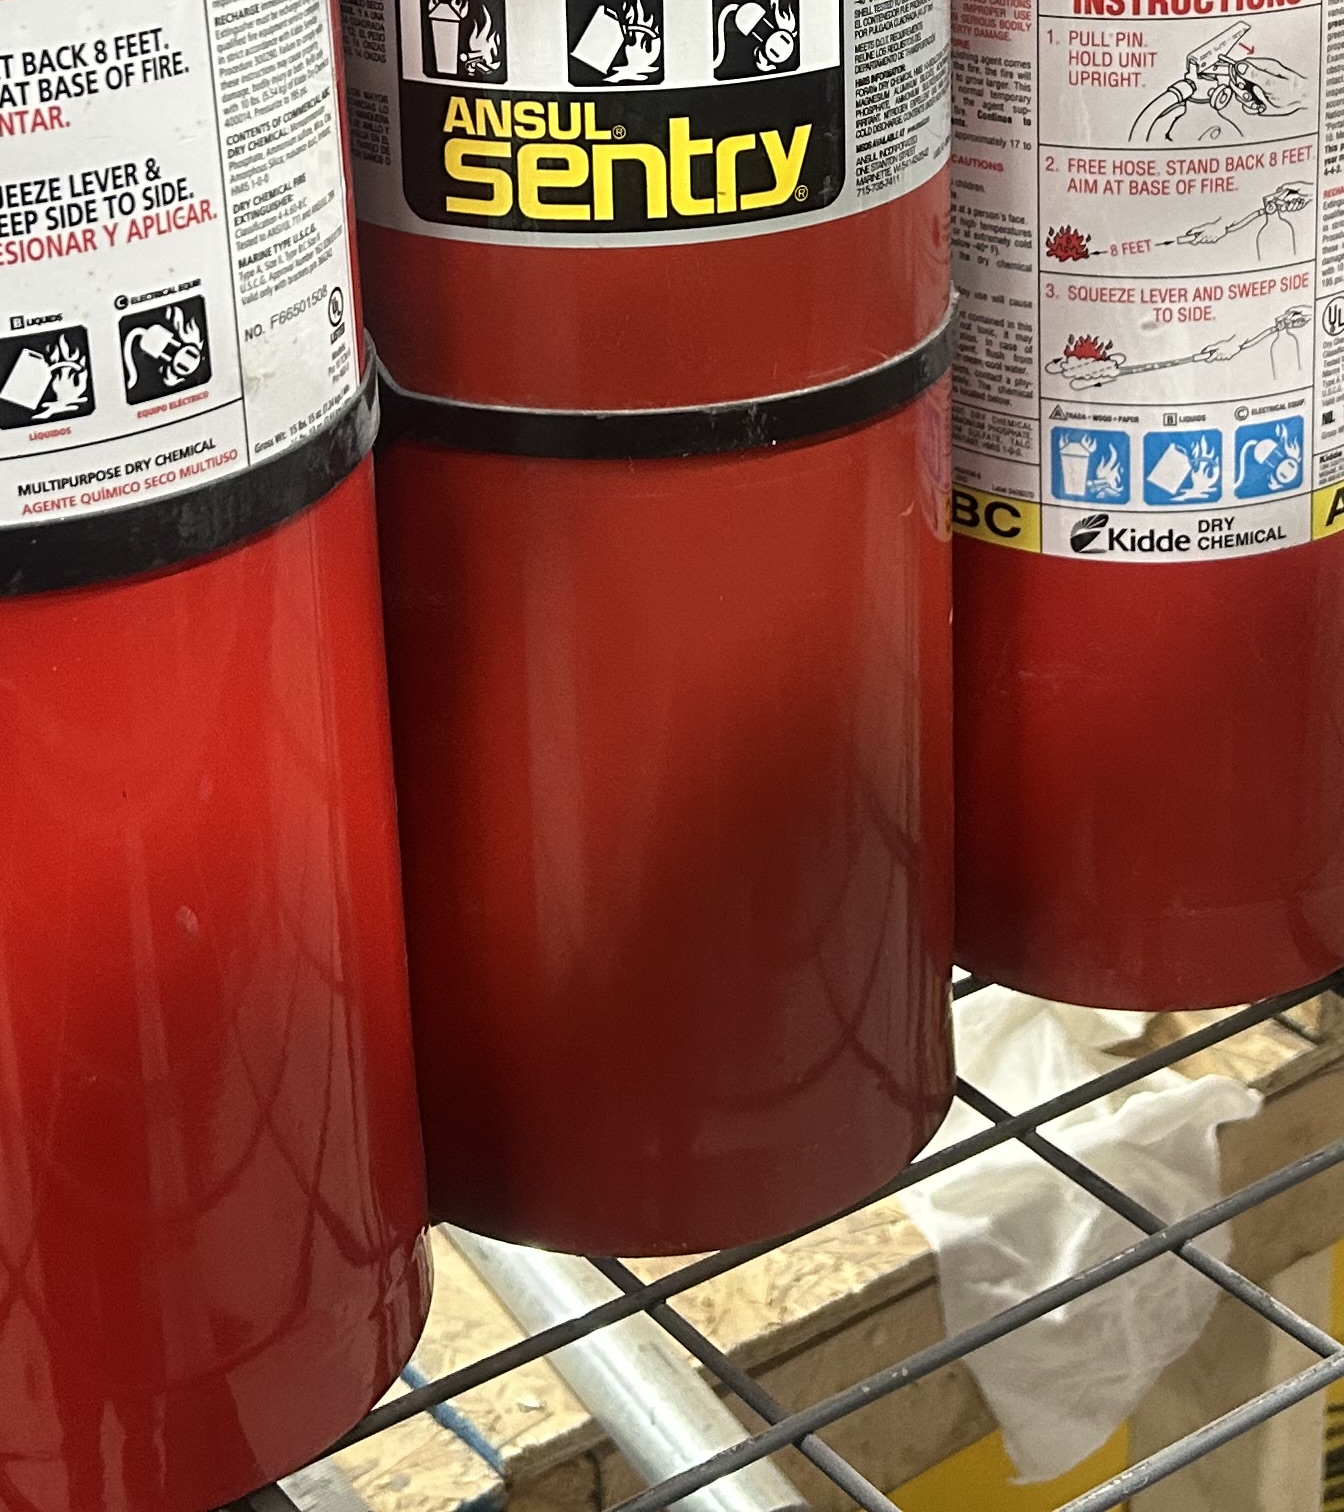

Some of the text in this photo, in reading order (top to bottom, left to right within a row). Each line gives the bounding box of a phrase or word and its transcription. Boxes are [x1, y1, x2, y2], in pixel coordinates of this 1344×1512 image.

[1046, 29, 1148, 48] 1. PULL PIN.
[23, 44, 87, 75] BACK
[94, 41, 106, 63] 8
[1069, 51, 1157, 68] HOLD UNIT
[41, 71, 99, 102] BASE
[105, 65, 136, 90] OF
[141, 51, 190, 85] FIRE.
[1069, 70, 1146, 88] UPRIGHT.
[1045, 158, 1059, 173] 2.
[1068, 158, 1108, 176] FREE
[1166, 158, 1220, 174] STAND
[1224, 156, 1265, 174] BACK
[1269, 151, 1278, 167] 8
[67, 161, 138, 198] LEVER
[145, 158, 161, 182] &
[46, 200, 97, 231] SIDE
[102, 195, 134, 218] TO
[140, 176, 195, 213] SIDE.
[244, 326, 266, 343] NO.
[17, 438, 217, 497] MULTIPURPOSE DRY CHEMICAL
[1198, 516, 1235, 533] DRY
[1107, 529, 1286, 554] Kidde CHEMICAL
